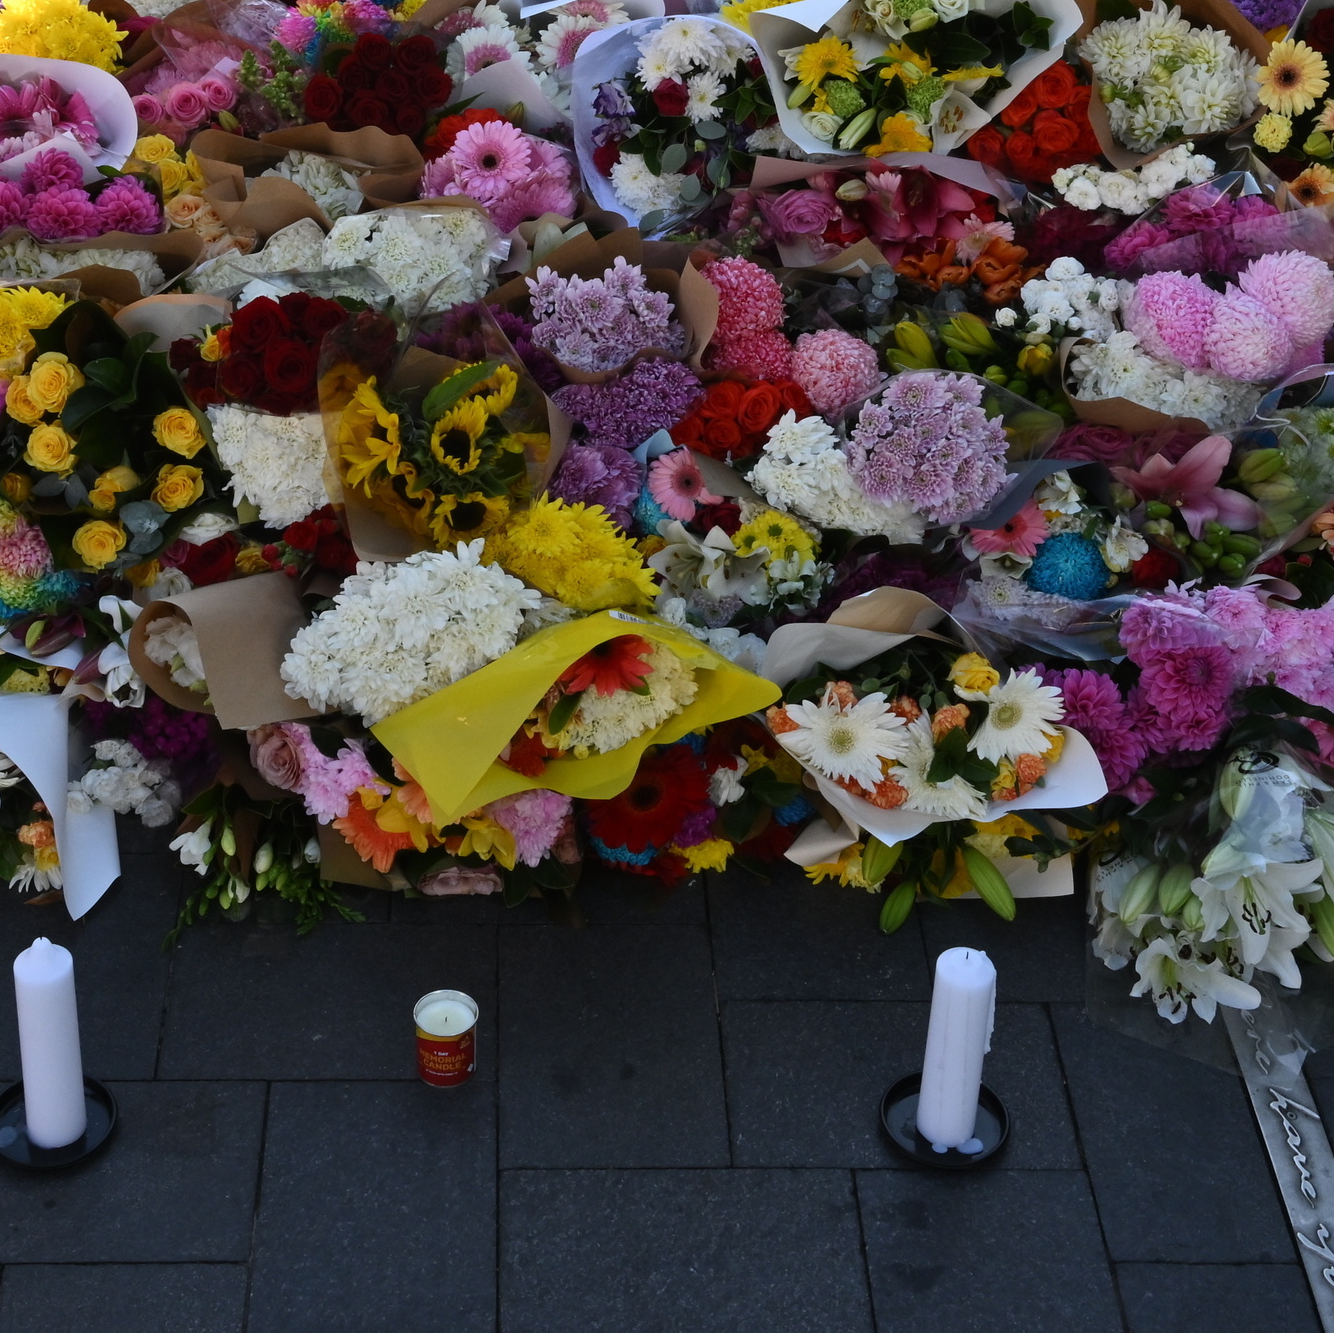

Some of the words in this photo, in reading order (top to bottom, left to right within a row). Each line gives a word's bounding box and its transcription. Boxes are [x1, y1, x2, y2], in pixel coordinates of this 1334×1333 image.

[420, 1048, 466, 1063] MEMORIAL
[424, 1058, 461, 1070] CANDLE
[1269, 1087, 1321, 1209] have
